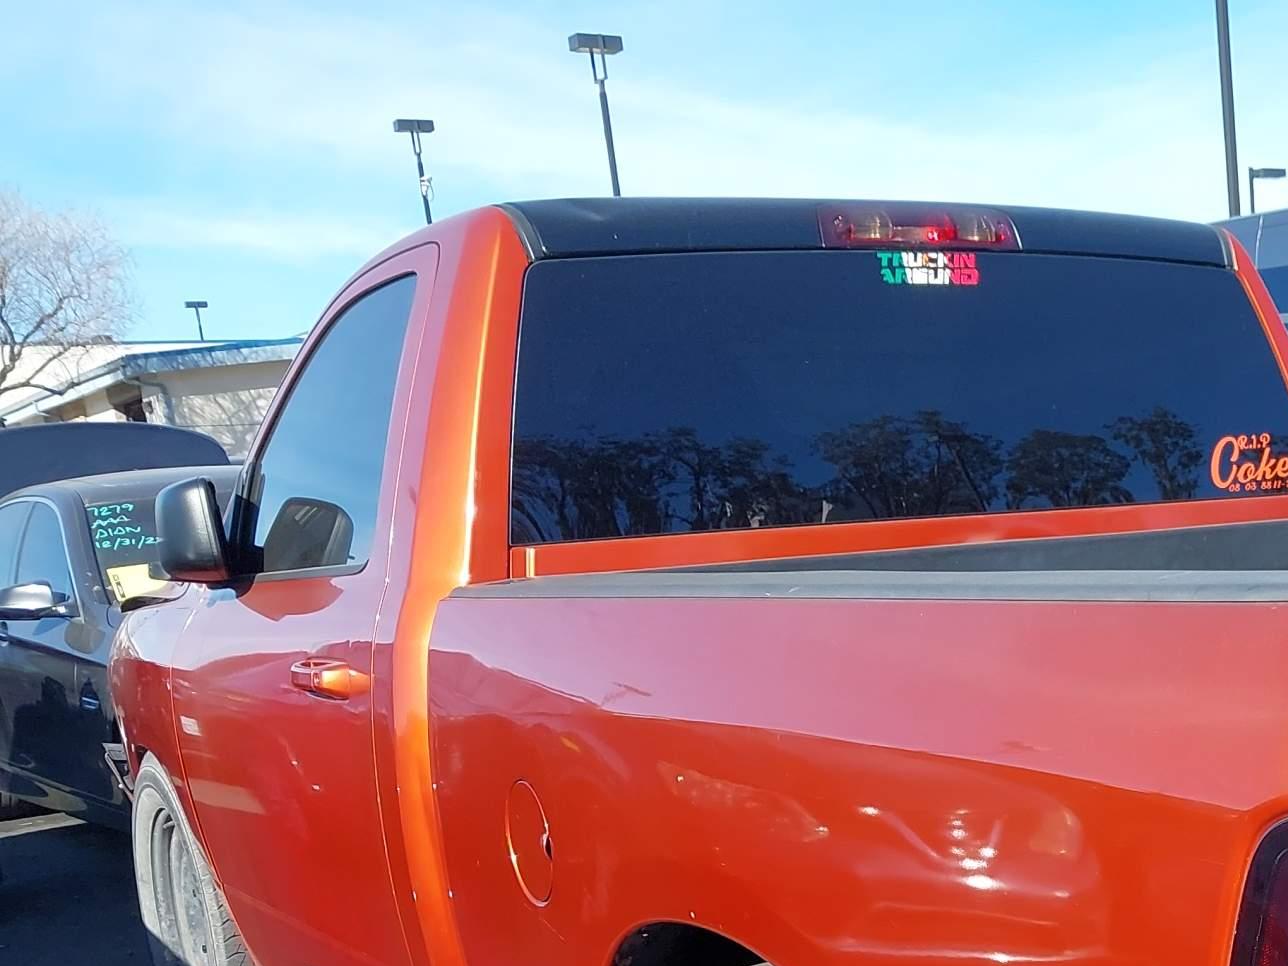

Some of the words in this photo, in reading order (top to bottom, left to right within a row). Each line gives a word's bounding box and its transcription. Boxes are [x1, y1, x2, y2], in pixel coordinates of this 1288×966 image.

[876, 251, 977, 268] TRUCKIN
[880, 268, 980, 285] AROUND
[86, 503, 134, 517] 7279
